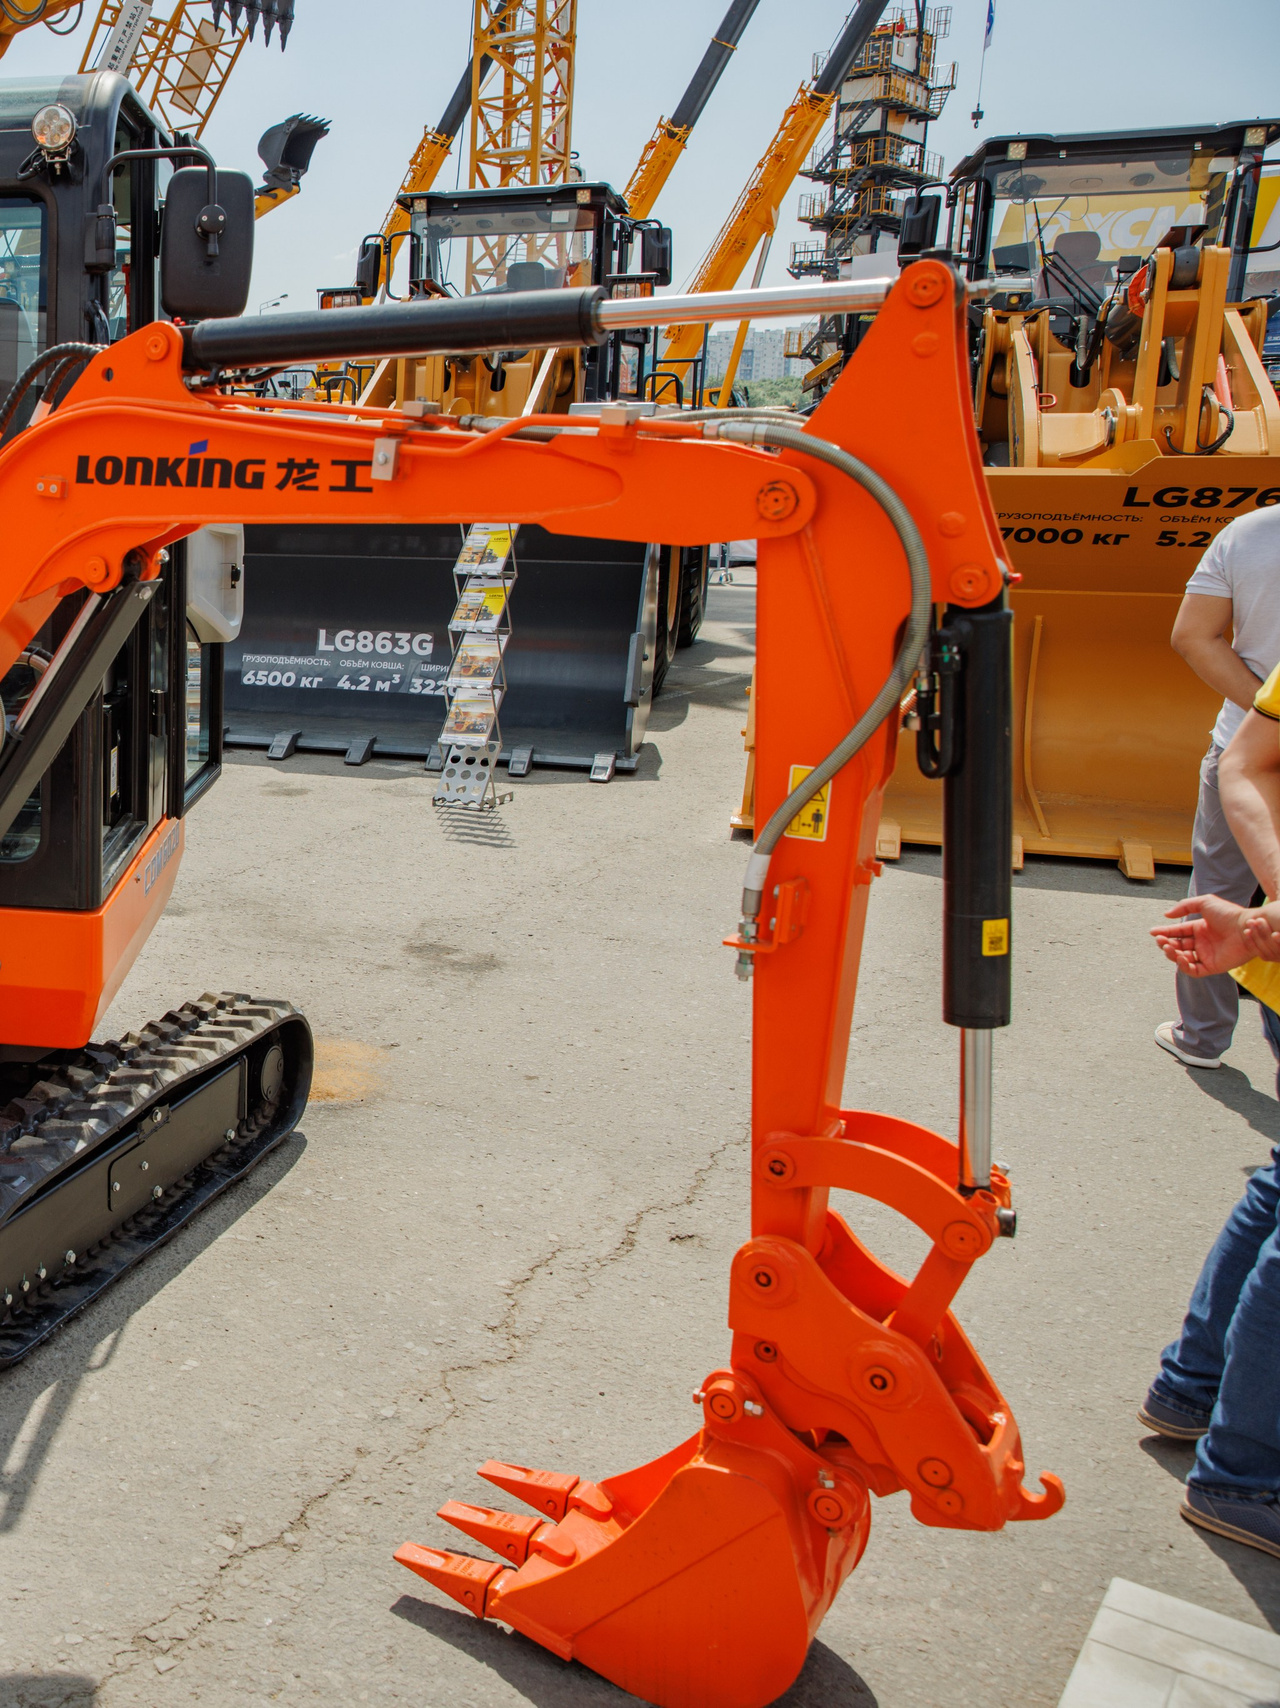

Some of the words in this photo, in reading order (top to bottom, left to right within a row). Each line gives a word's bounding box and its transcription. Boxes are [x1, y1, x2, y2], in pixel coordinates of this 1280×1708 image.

[76, 439, 266, 490] LONKING
[275, 457, 373, 493] 龙工
[1160, 513, 1211, 523] ОБЪЁМ
[1000, 527, 1084, 545] 7000
[1092, 533, 1130, 545] кг
[318, 628, 433, 655] LG863G
[242, 654, 331, 667] ГРУЗОПОДЪЁМНОСТЬ:
[339, 659, 368, 669] ОБЪЁМ
[371, 661, 405, 670] КОВША:
[242, 670, 296, 687] 6500
[300, 675, 323, 688] кг
[337, 674, 371, 691] 4.2
